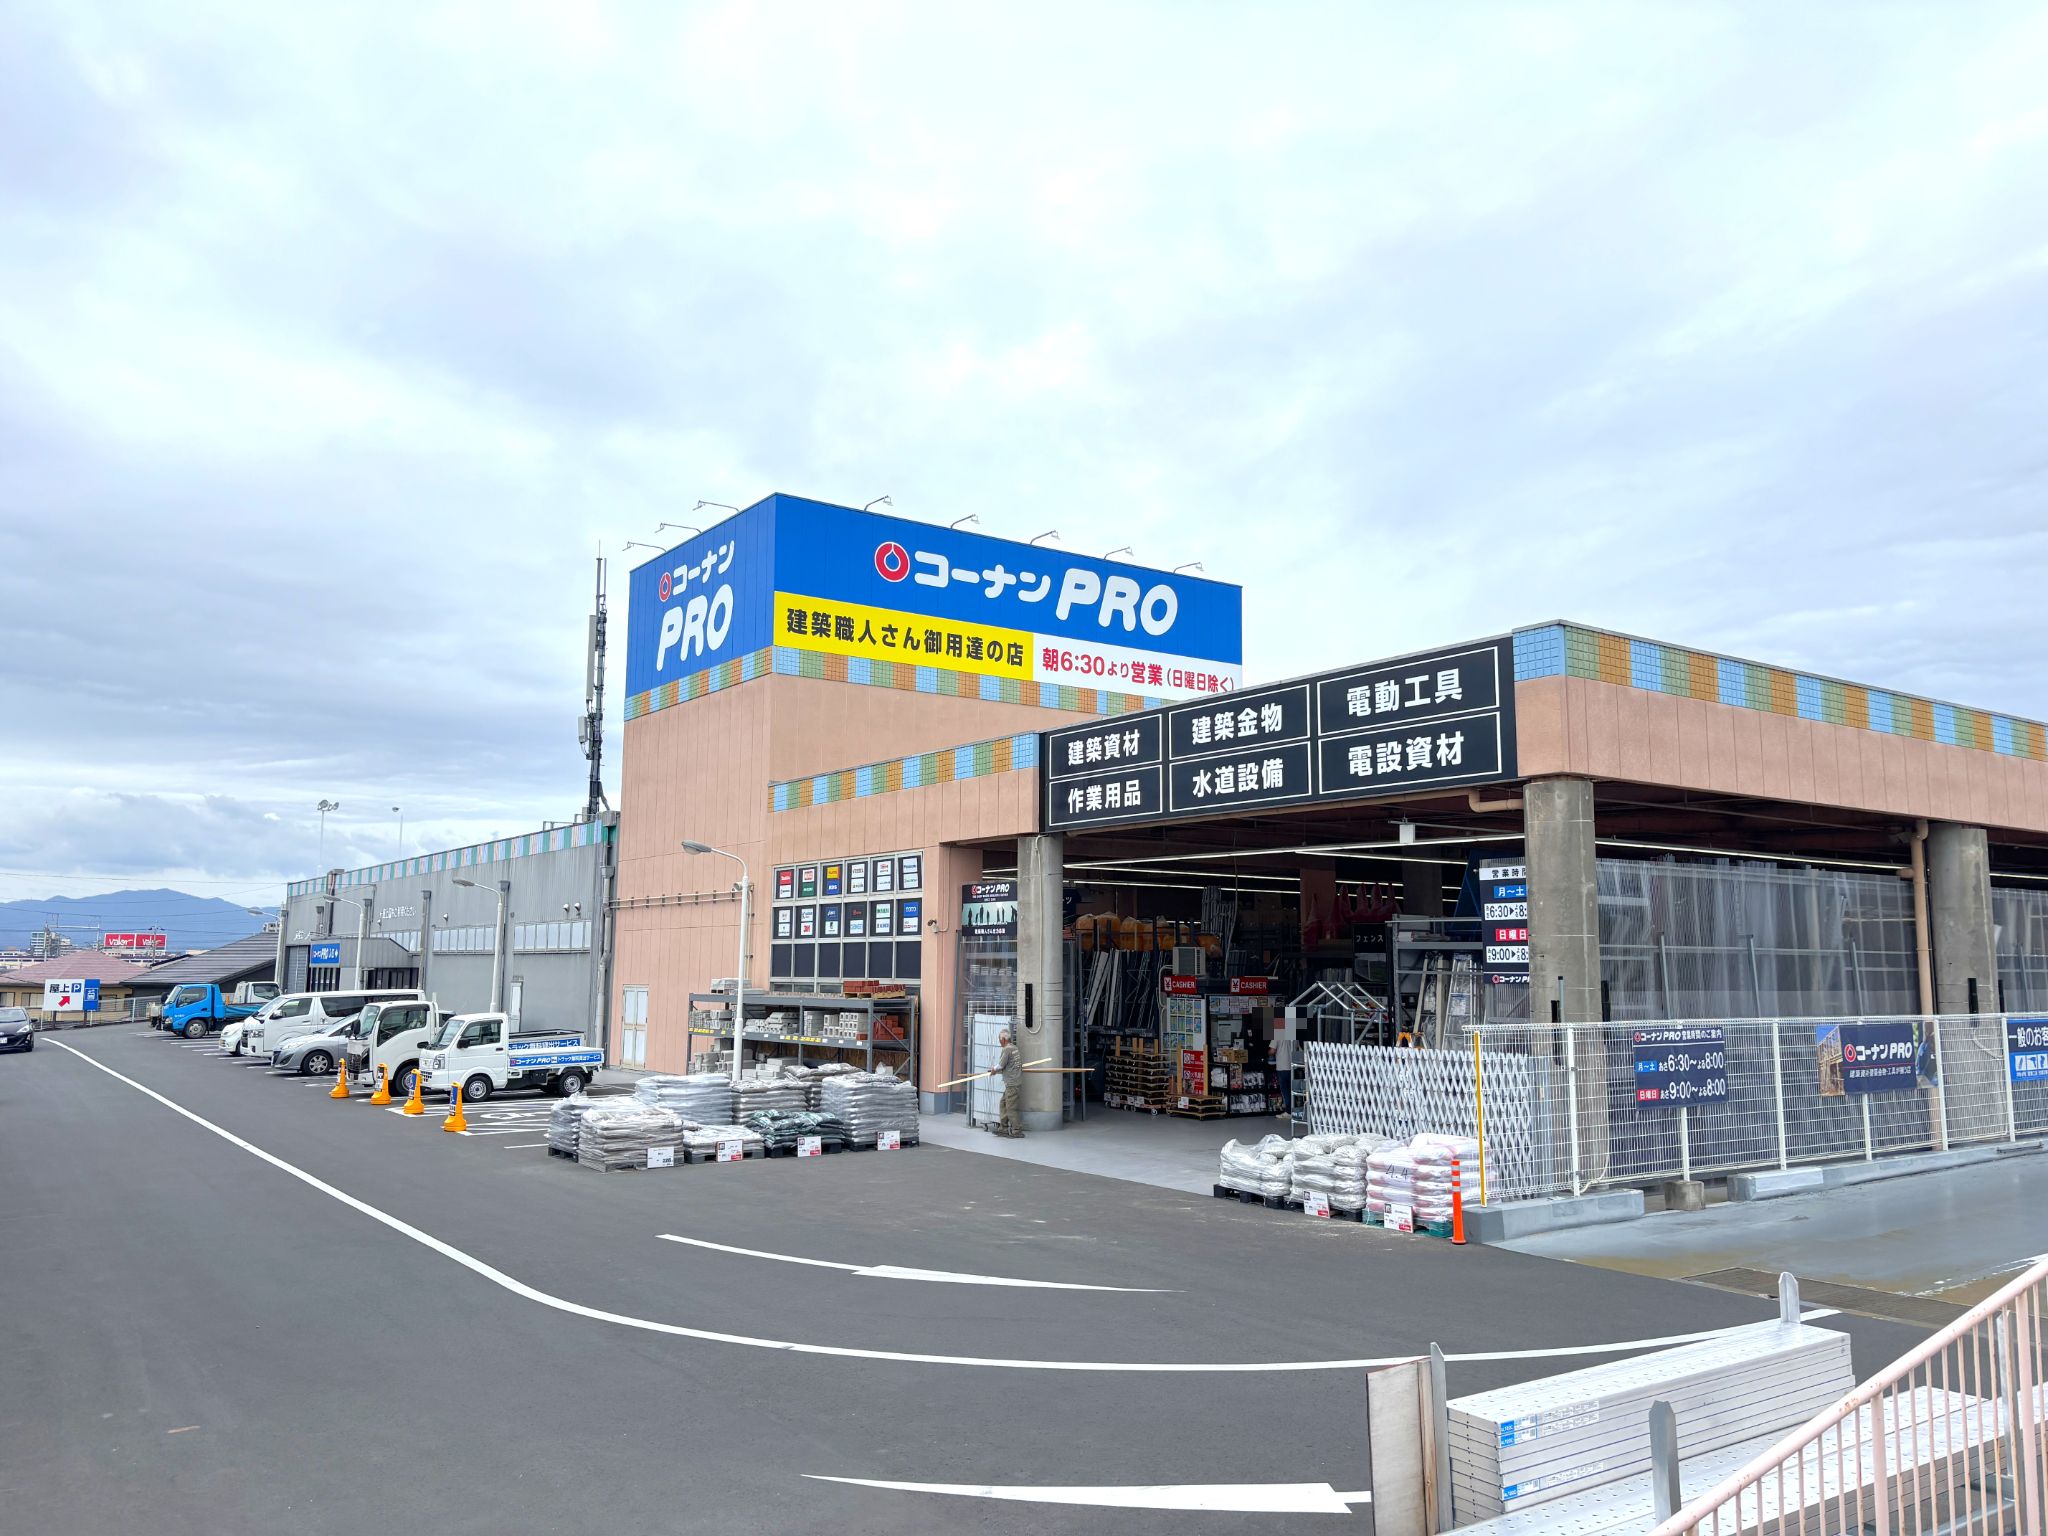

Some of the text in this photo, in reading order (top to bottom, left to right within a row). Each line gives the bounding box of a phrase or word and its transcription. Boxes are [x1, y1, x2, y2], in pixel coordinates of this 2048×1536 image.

[673, 540, 734, 595] コーナン
[1055, 568, 1178, 636] PRO
[656, 584, 734, 671] PRO
[786, 608, 1023, 667] 建築職人さん御用達の店
[1346, 668, 1463, 717] 電動工具
[1191, 702, 1283, 745] 建築金物
[1067, 729, 1141, 766] 建築資材
[1347, 730, 1465, 777] 電設資材
[1067, 779, 1141, 814] 作業用品
[1192, 758, 1284, 798] 水道設備
[1356, 935, 1384, 943] フェンス
[1172, 981, 1195, 989] CASHIER
[1241, 981, 1267, 989] CASHIER
[1855, 1041, 1913, 1061] コーナン PRO
